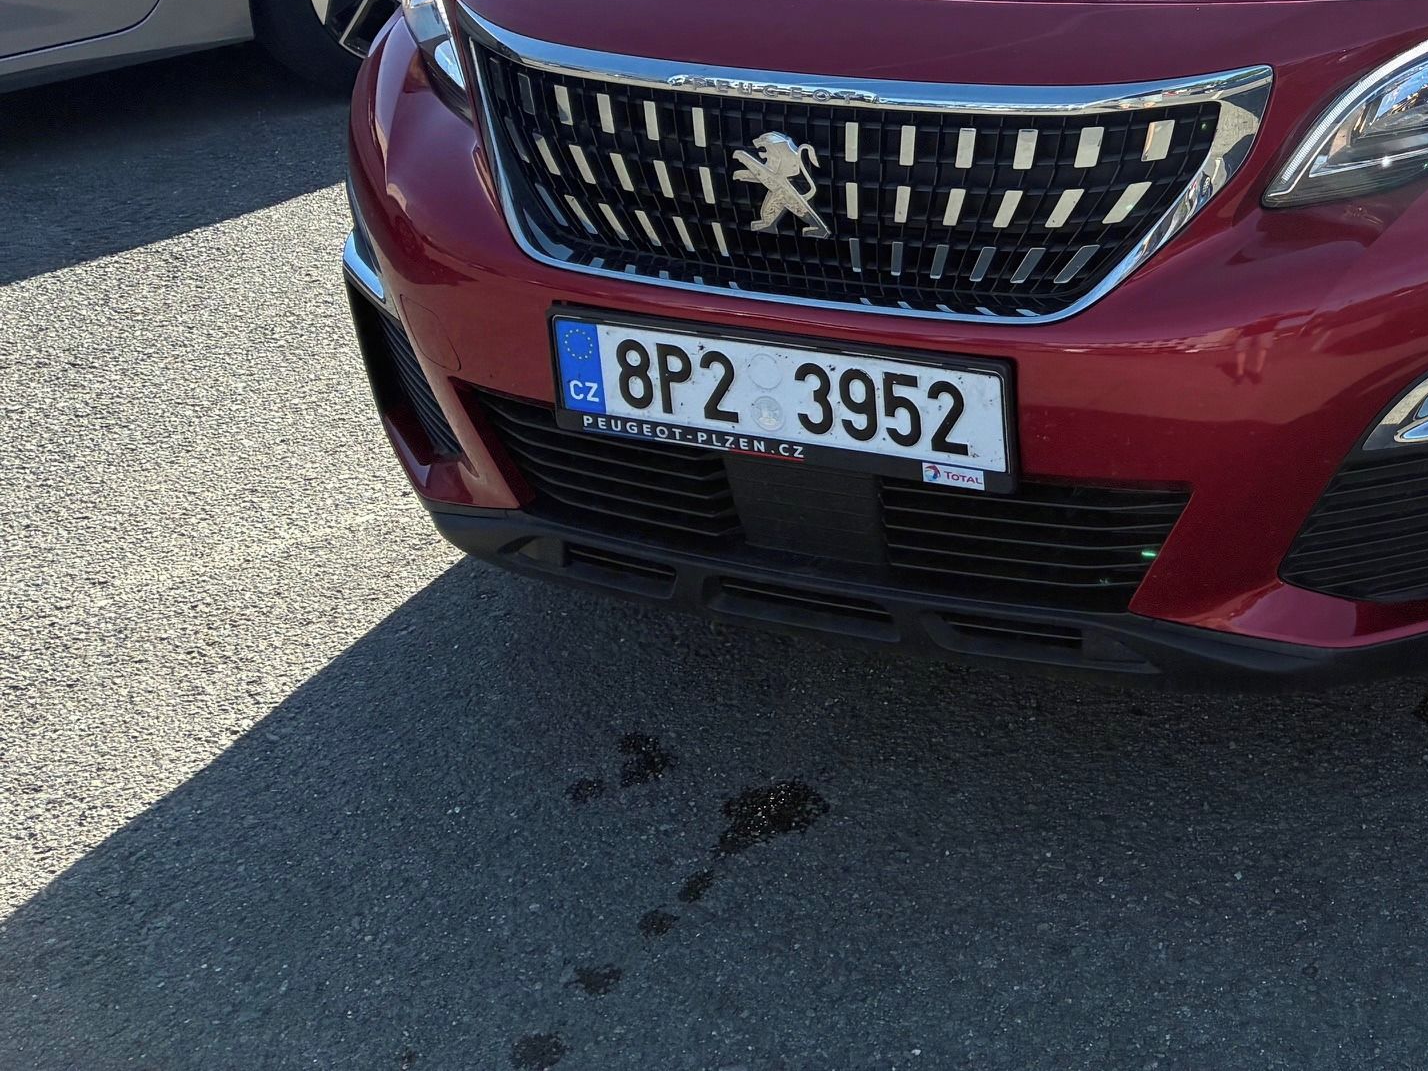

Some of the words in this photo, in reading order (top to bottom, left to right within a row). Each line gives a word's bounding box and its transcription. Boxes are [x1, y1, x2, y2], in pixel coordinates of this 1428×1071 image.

[692, 76, 858, 105] PEUGEOT
[569, 379, 600, 403] CZ
[615, 338, 739, 424] 8P2
[794, 362, 970, 456] 3952
[583, 415, 805, 458] PEUGEOT-PLZEN.CZ
[944, 470, 983, 485] TOTAL
